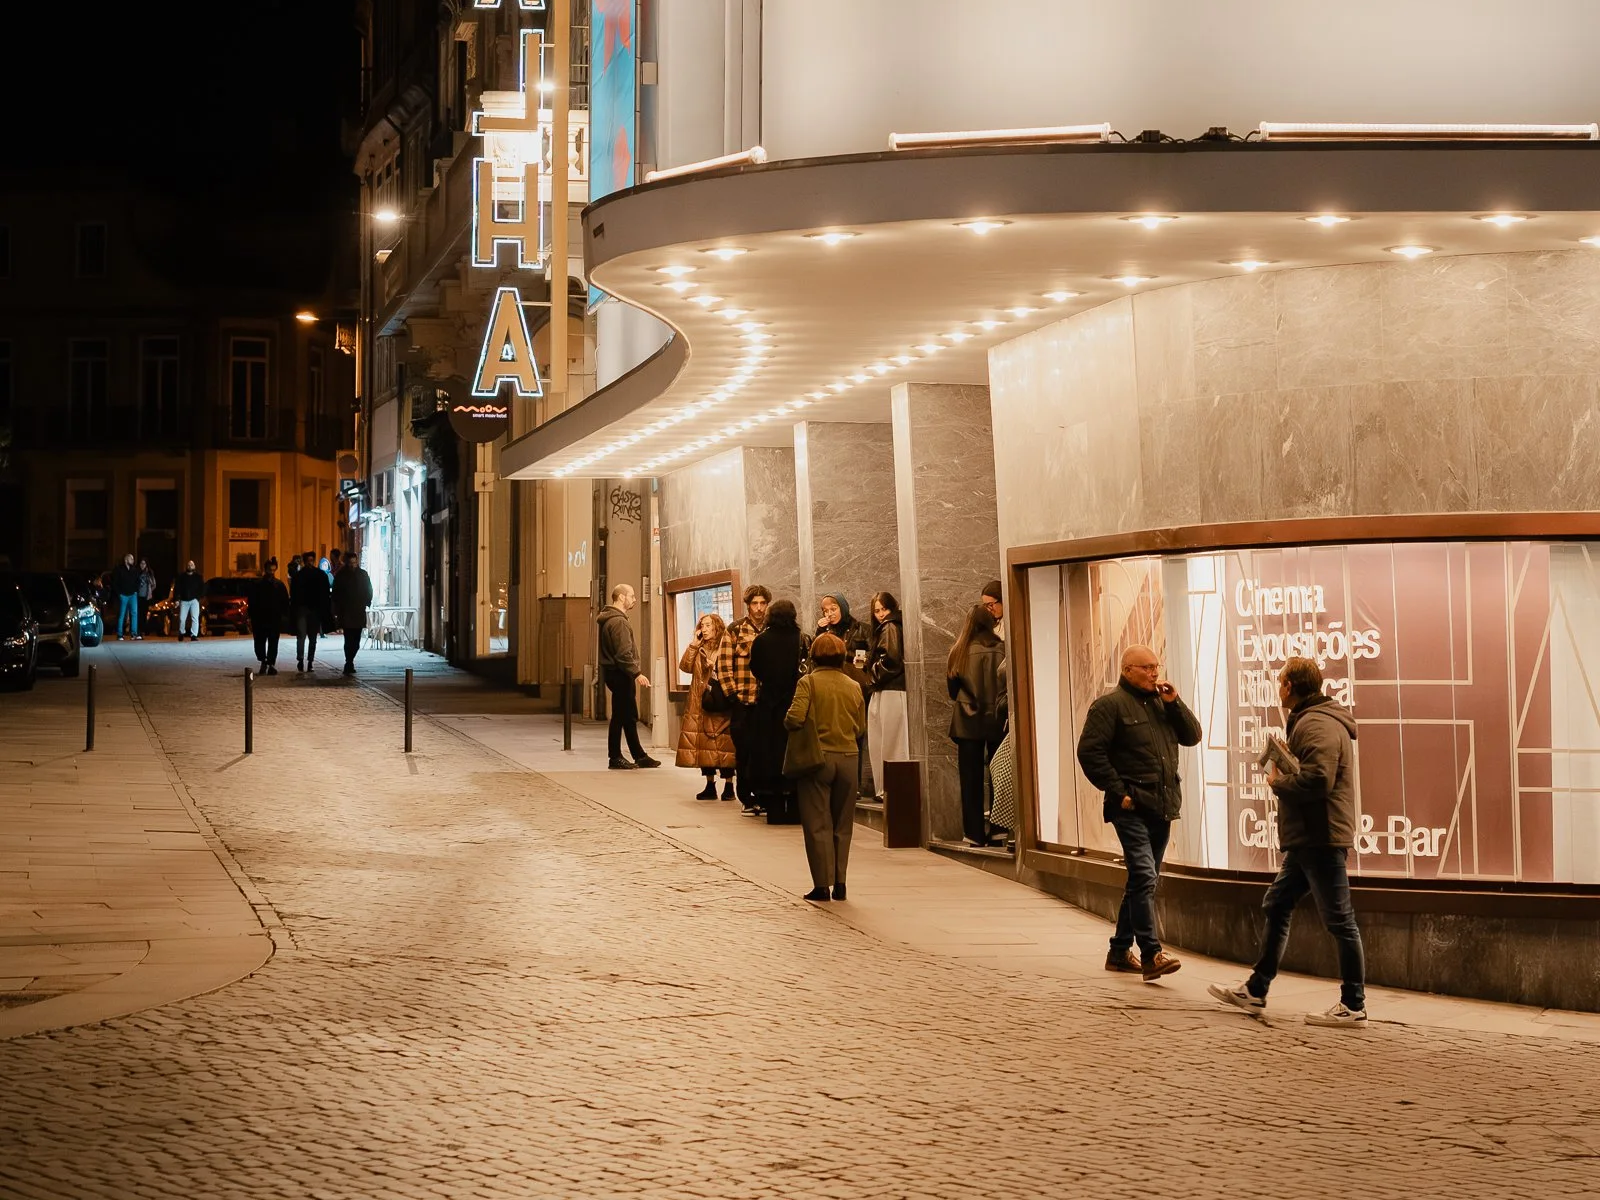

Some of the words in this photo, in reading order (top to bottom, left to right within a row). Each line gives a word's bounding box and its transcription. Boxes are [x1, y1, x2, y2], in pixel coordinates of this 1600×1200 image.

[1235, 579, 1326, 617] Cinema
[1237, 621, 1381, 670] Exposições
[1354, 814, 1382, 854] &
[1387, 815, 1446, 857] Bar
